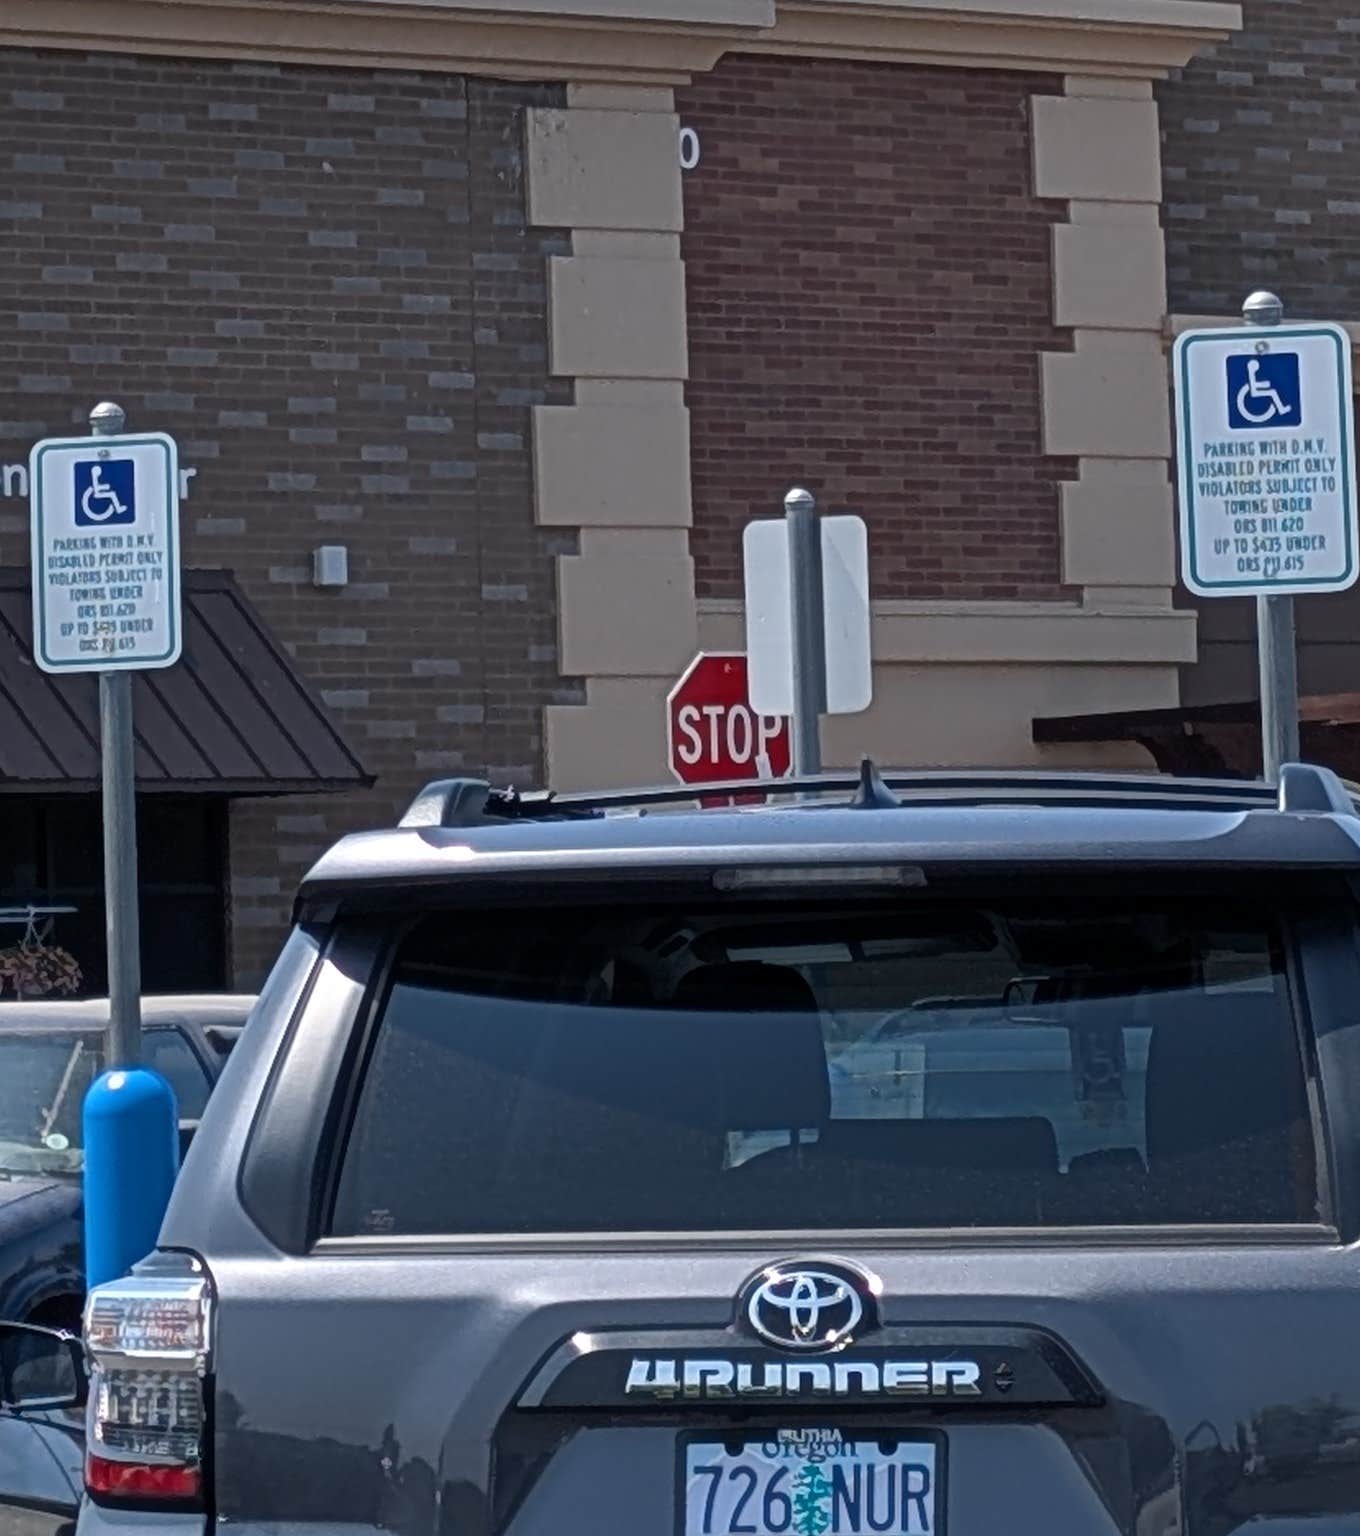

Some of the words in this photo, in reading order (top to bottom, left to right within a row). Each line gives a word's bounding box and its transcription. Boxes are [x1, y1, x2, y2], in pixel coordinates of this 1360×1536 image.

[1204, 442, 1254, 458] PARKING
[1260, 440, 1287, 455] WITH
[1292, 438, 1328, 455] D.M.V.
[1198, 460, 1254, 478] DISABLED
[1259, 458, 1300, 474] PERMIT
[1305, 456, 1336, 472] ONLY
[1199, 480, 1262, 496] VIOLATORS
[1266, 477, 1317, 494] SUBJECT
[1322, 476, 1336, 492] TO
[1224, 499, 1268, 514] TOWING
[1272, 498, 1312, 513] UNDER
[1234, 518, 1257, 534] ORS
[54, 536, 96, 552] PARKING
[1214, 538, 1230, 554] UP
[1234, 538, 1248, 554] TO
[1286, 535, 1326, 551] UNDER
[48, 554, 96, 569] DISABLED
[100, 552, 134, 566] PERMIT
[137, 552, 163, 565] ONLY
[1237, 557, 1260, 572] ORS
[48, 570, 102, 585] VIOLATORS
[105, 568, 147, 583] SUBJECT
[152, 568, 162, 581] TO
[110, 586, 143, 600] UNDER
[121, 618, 154, 632] UNDER
[678, 705, 782, 764] STOP
[625, 1358, 982, 1399] 4RUNNER
[762, 1440, 858, 1463] Oregon
[693, 1465, 792, 1534] 726
[832, 1464, 930, 1533] NUR
